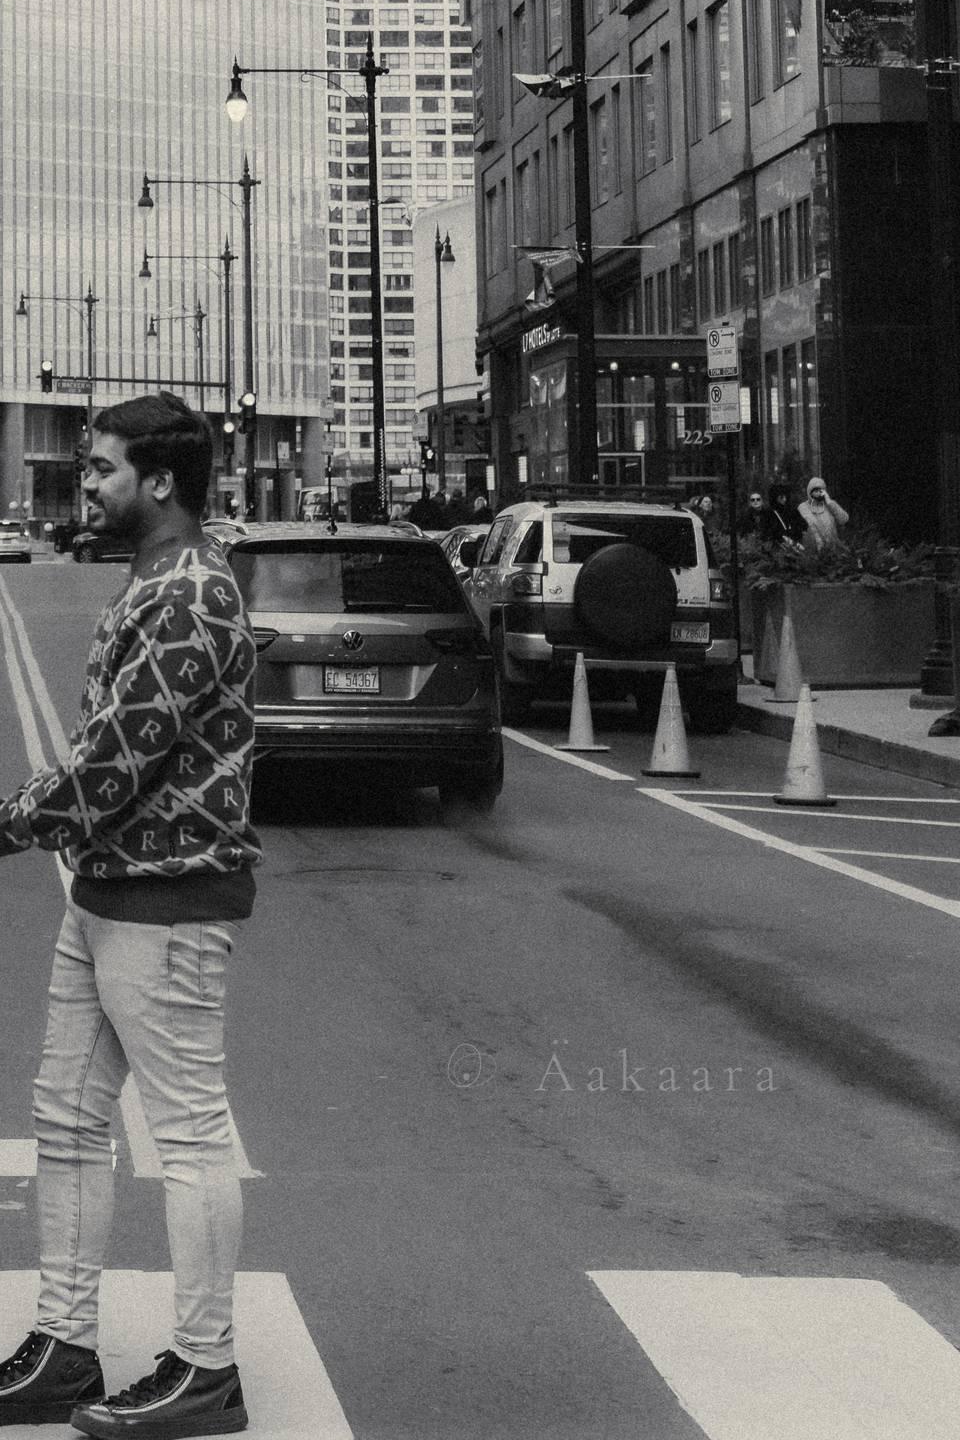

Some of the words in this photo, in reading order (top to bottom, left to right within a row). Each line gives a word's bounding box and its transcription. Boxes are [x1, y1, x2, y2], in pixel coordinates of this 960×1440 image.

[528, 323, 549, 350] HOTELS
[683, 430, 713, 445] 225
[213, 586, 233, 607] R
[156, 605, 175, 630] R
[178, 658, 200, 683] R
[345, 672, 377, 688] 54367
[140, 719, 162, 744] R
[224, 720, 238, 741] R
[179, 754, 194, 774] R
[97, 777, 119, 802] R
[223, 788, 238, 808] R
[142, 830, 158, 851] R
[179, 826, 200, 846] R
